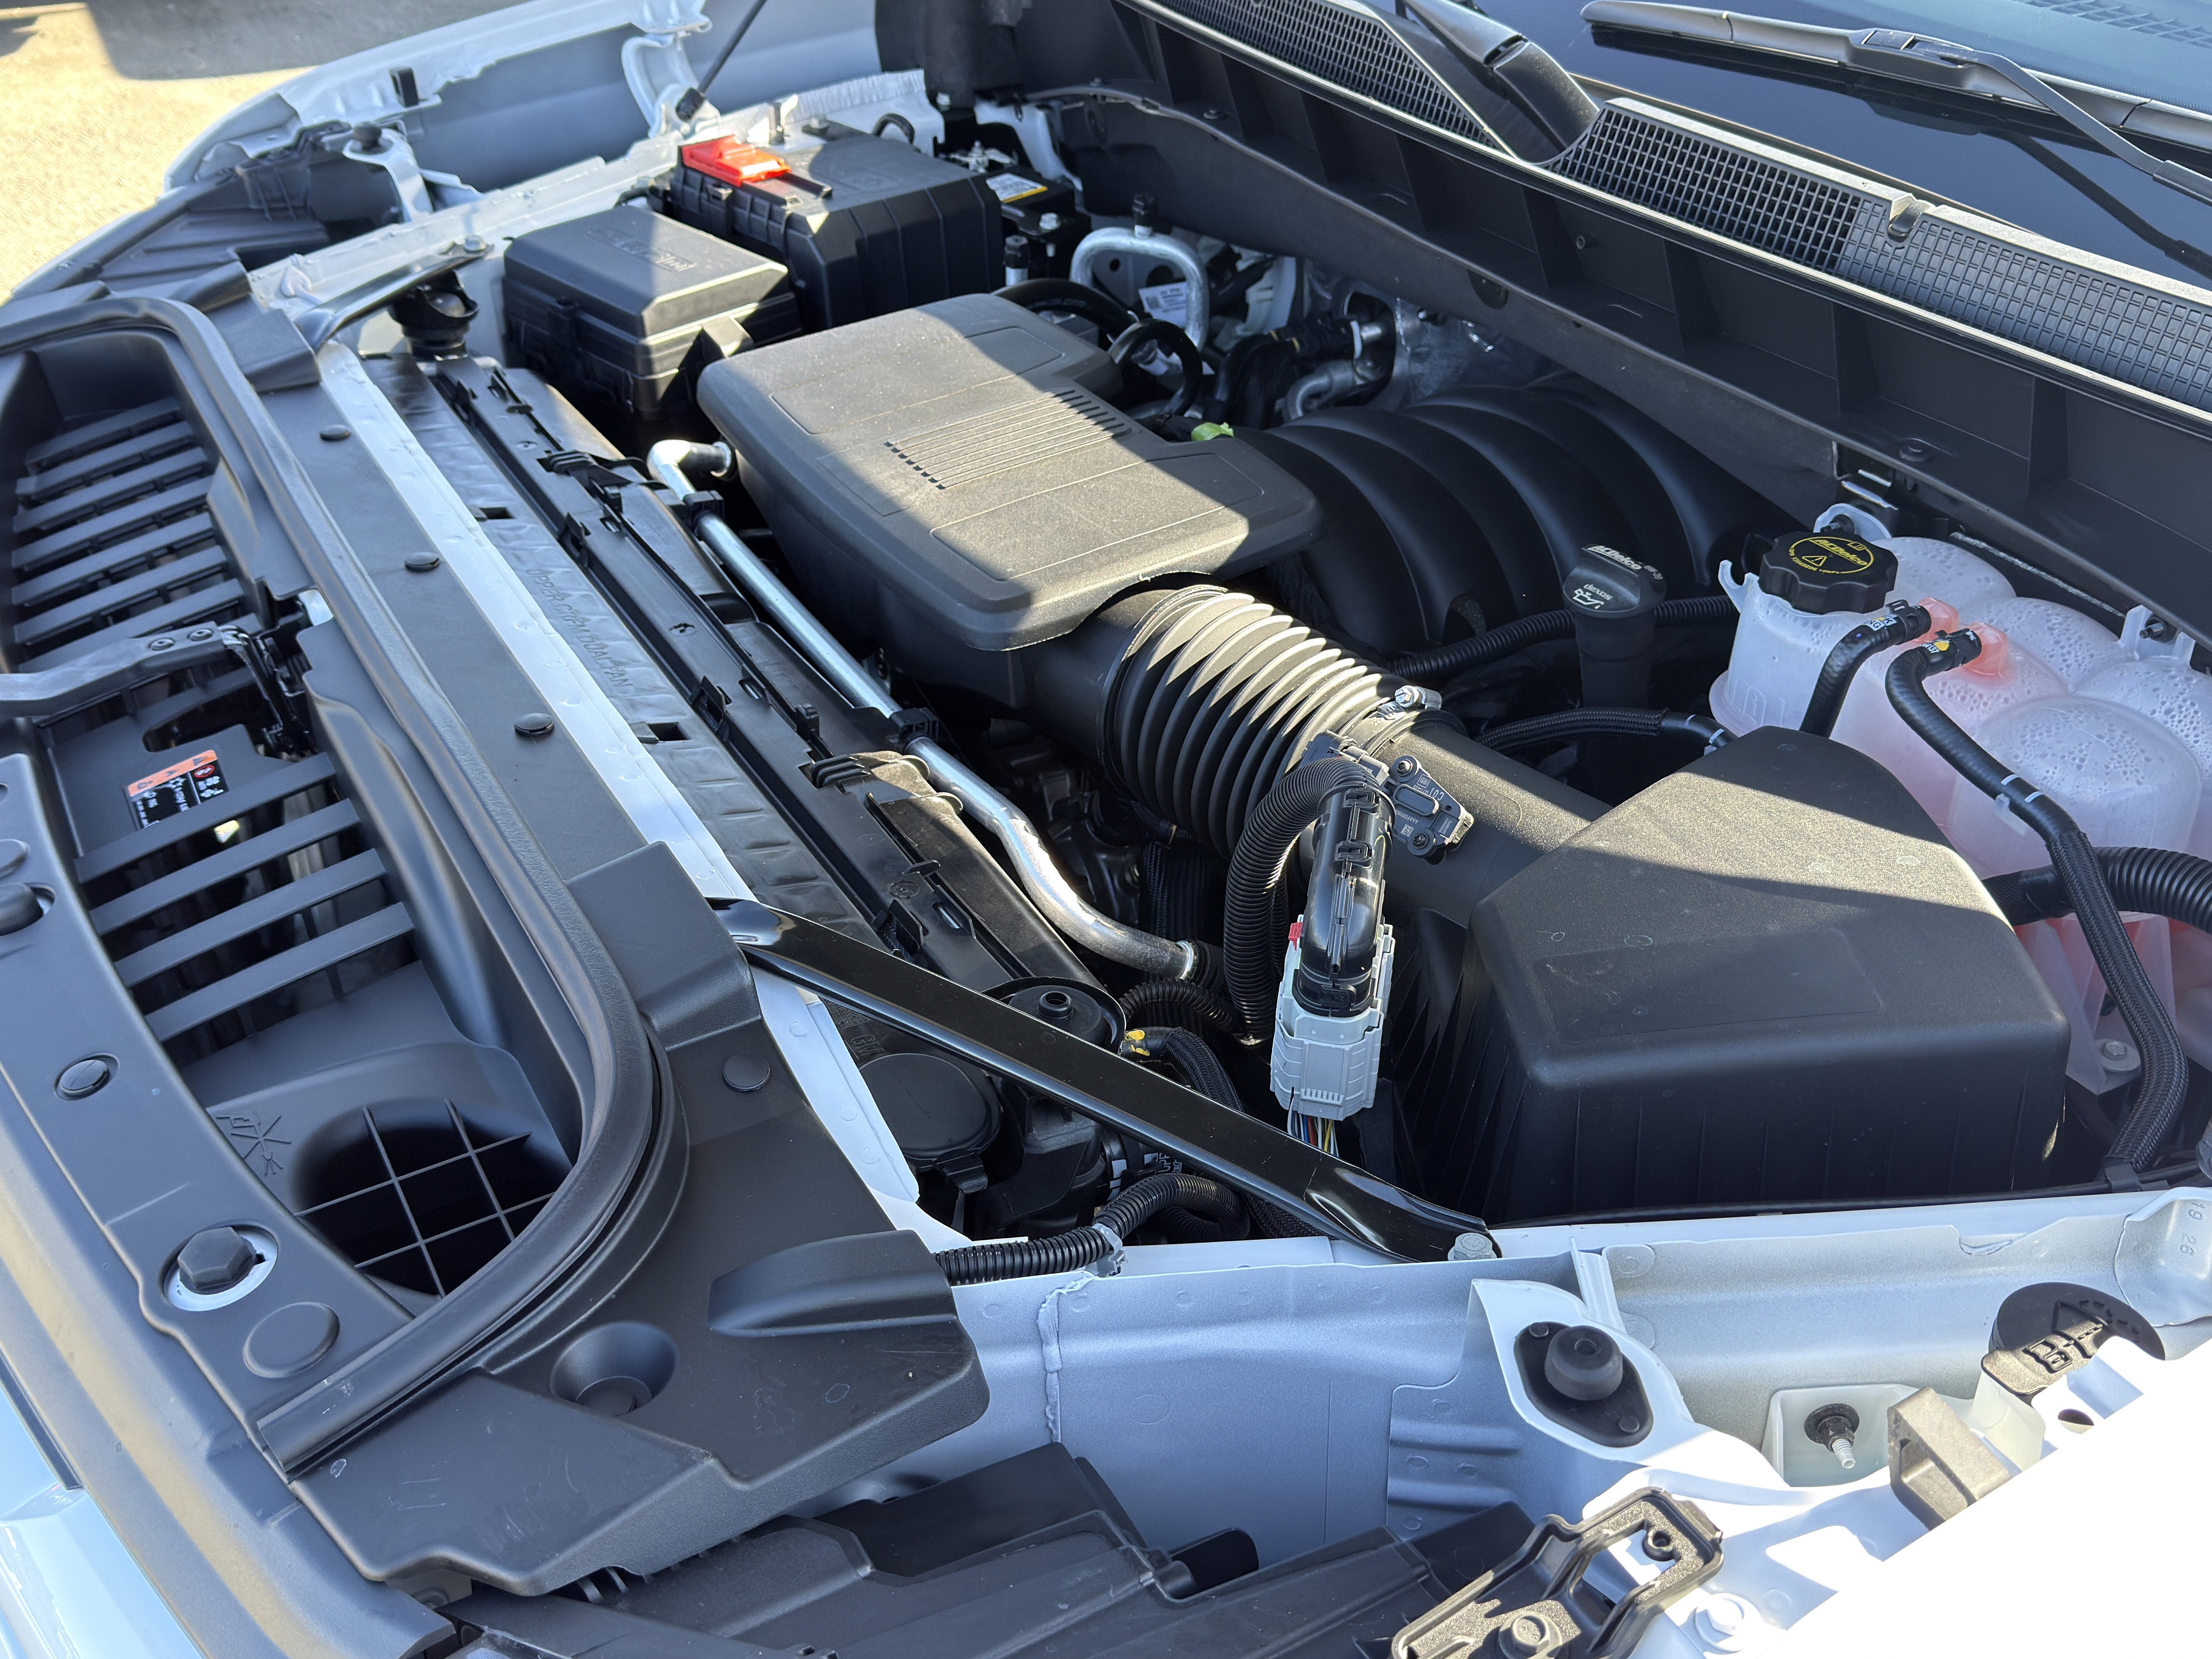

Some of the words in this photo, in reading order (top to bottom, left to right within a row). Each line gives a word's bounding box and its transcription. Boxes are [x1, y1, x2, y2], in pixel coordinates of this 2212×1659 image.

[1587, 545, 1642, 570] ACDelco
[1812, 539, 1868, 566] ACDelco
[1644, 565, 1664, 580] 0W-20
[526, 568, 565, 602] UPPER
[1583, 584, 1613, 601] dexos
[1429, 787, 1444, 801] C01
[853, 1034, 883, 1056] GM
[2188, 1202, 2206, 1221] 19
[2180, 1233, 2197, 1256] 26
